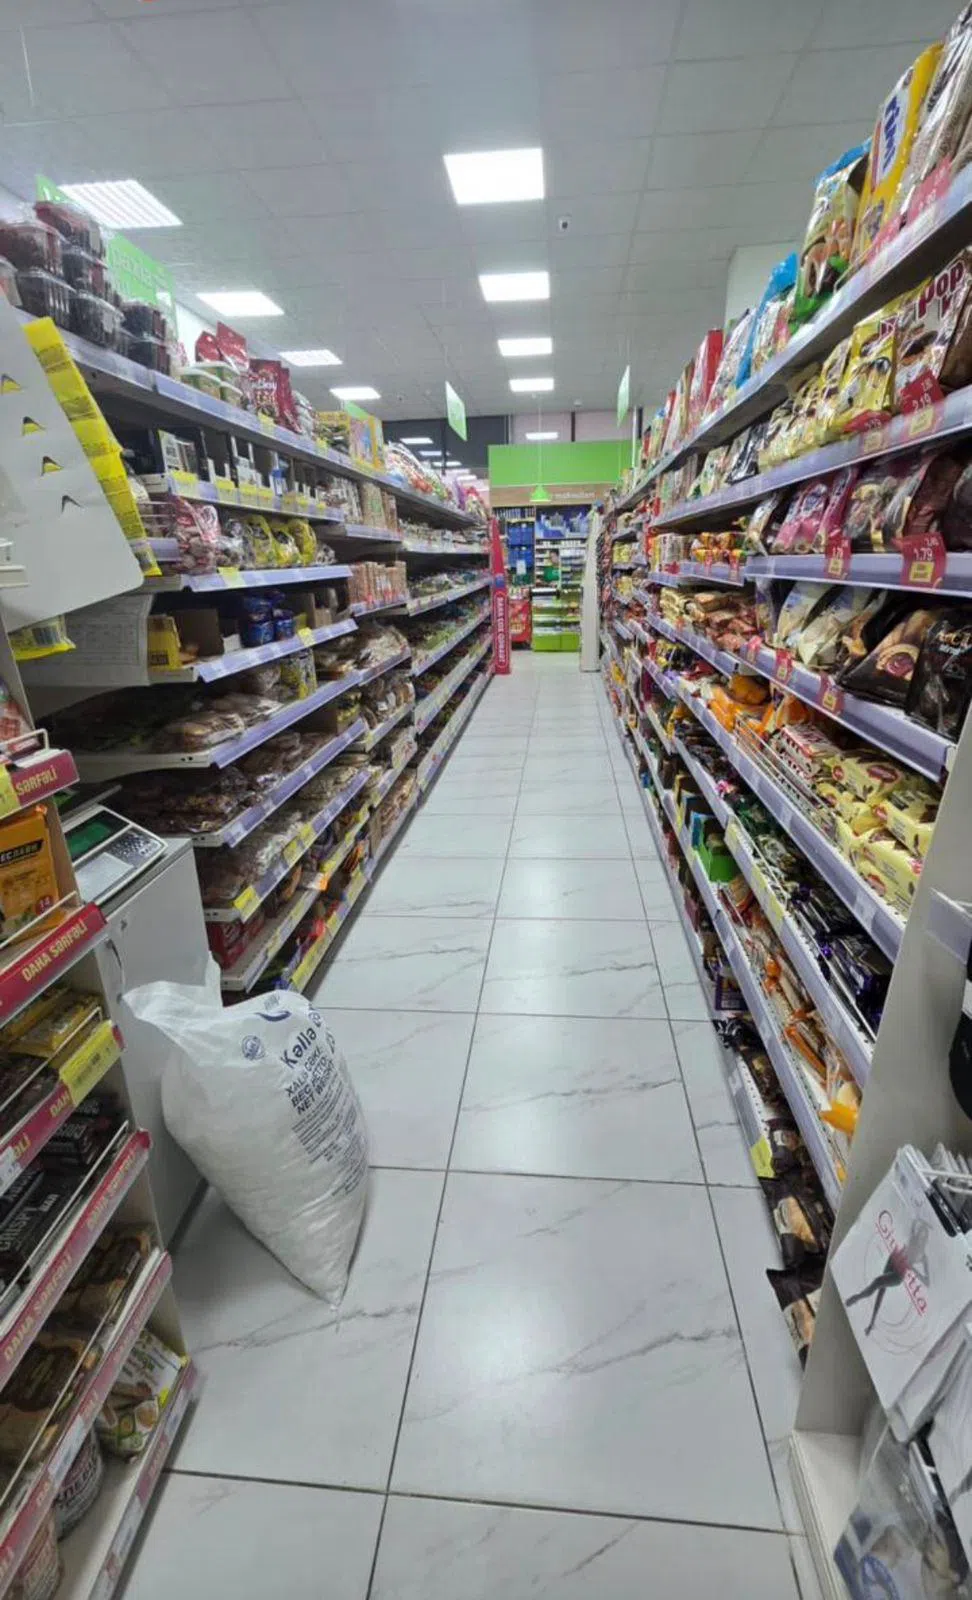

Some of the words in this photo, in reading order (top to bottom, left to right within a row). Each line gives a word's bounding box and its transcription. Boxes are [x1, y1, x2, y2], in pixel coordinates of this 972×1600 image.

[22, 951, 52, 982] DAHA
[280, 1027, 317, 1069] Kəllə
[297, 1091, 316, 1115] NET
